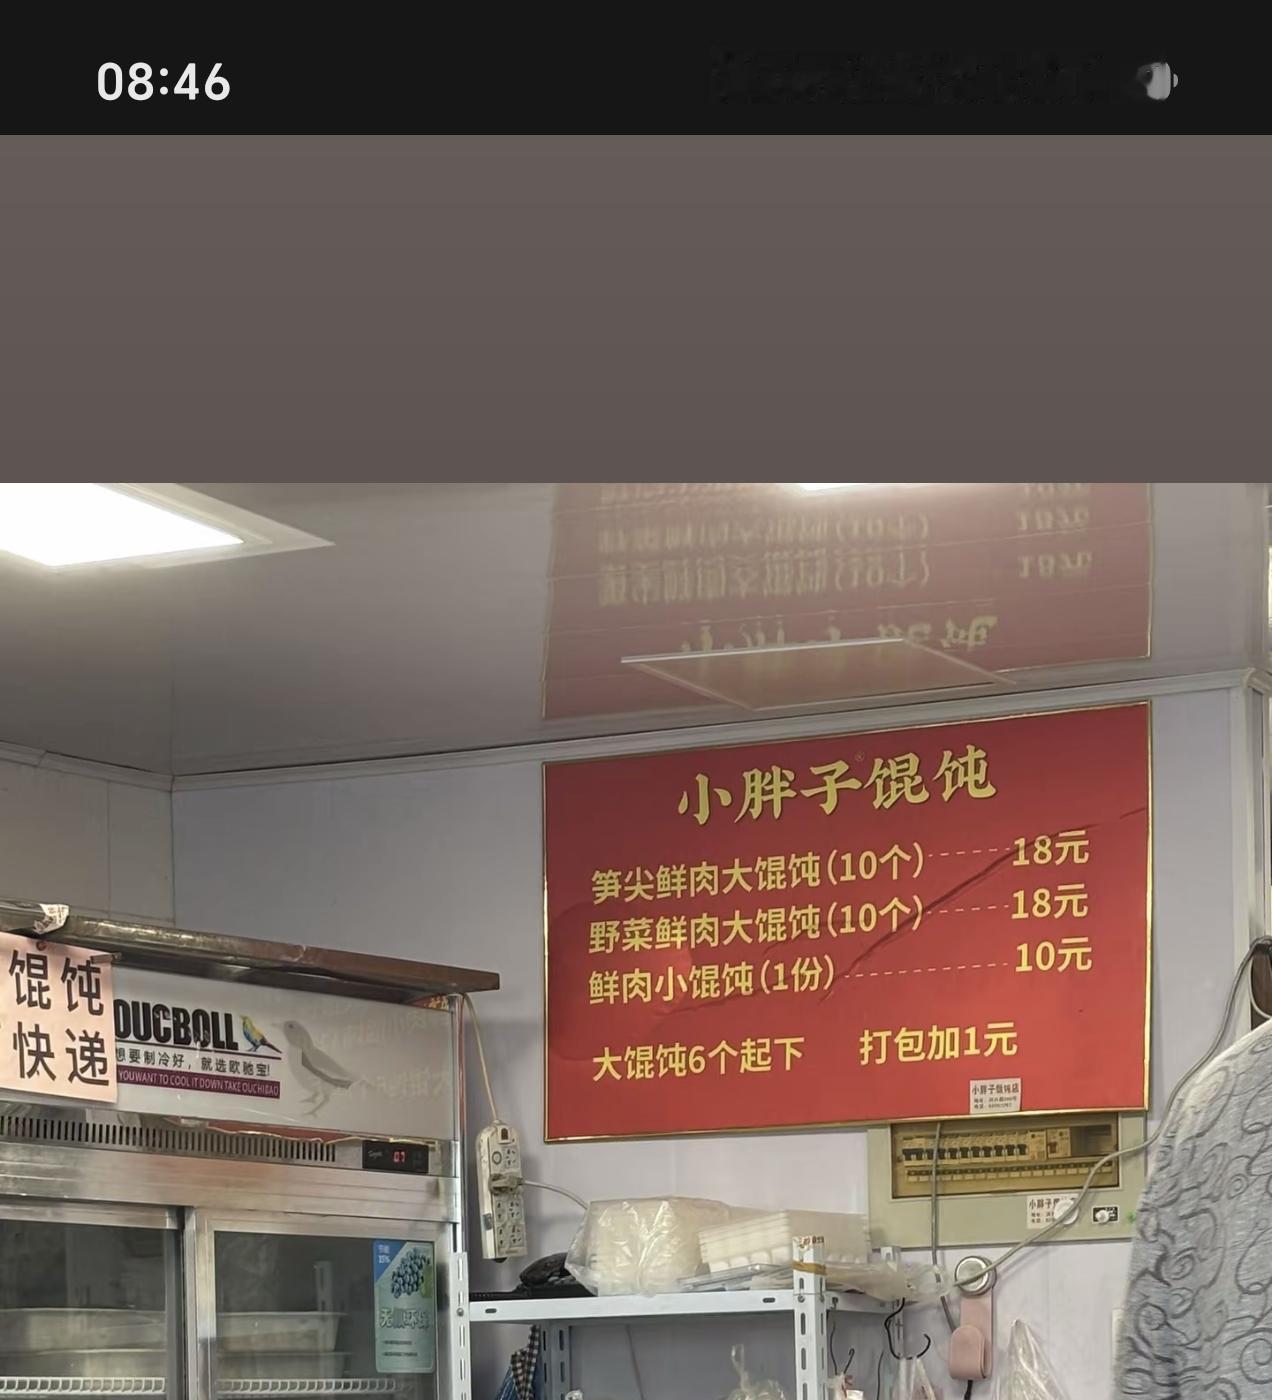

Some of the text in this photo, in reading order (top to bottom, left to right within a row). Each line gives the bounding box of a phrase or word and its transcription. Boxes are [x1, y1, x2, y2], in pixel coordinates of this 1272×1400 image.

[676, 743, 999, 826] 小胖子馄饨
[591, 829, 1090, 905] 笋尖鲜肉大馄饨(10个) 18元
[588, 882, 1089, 956] 野菜鲜肉大馄饨(10个) 18元
[8, 949, 104, 1017] 馄饨
[588, 936, 1093, 1007] 鲜肉小馄饨(1份) 10元
[12, 1021, 110, 1087] 快递
[592, 1021, 1018, 1083] 大馄饨6个起下 打包加1元
